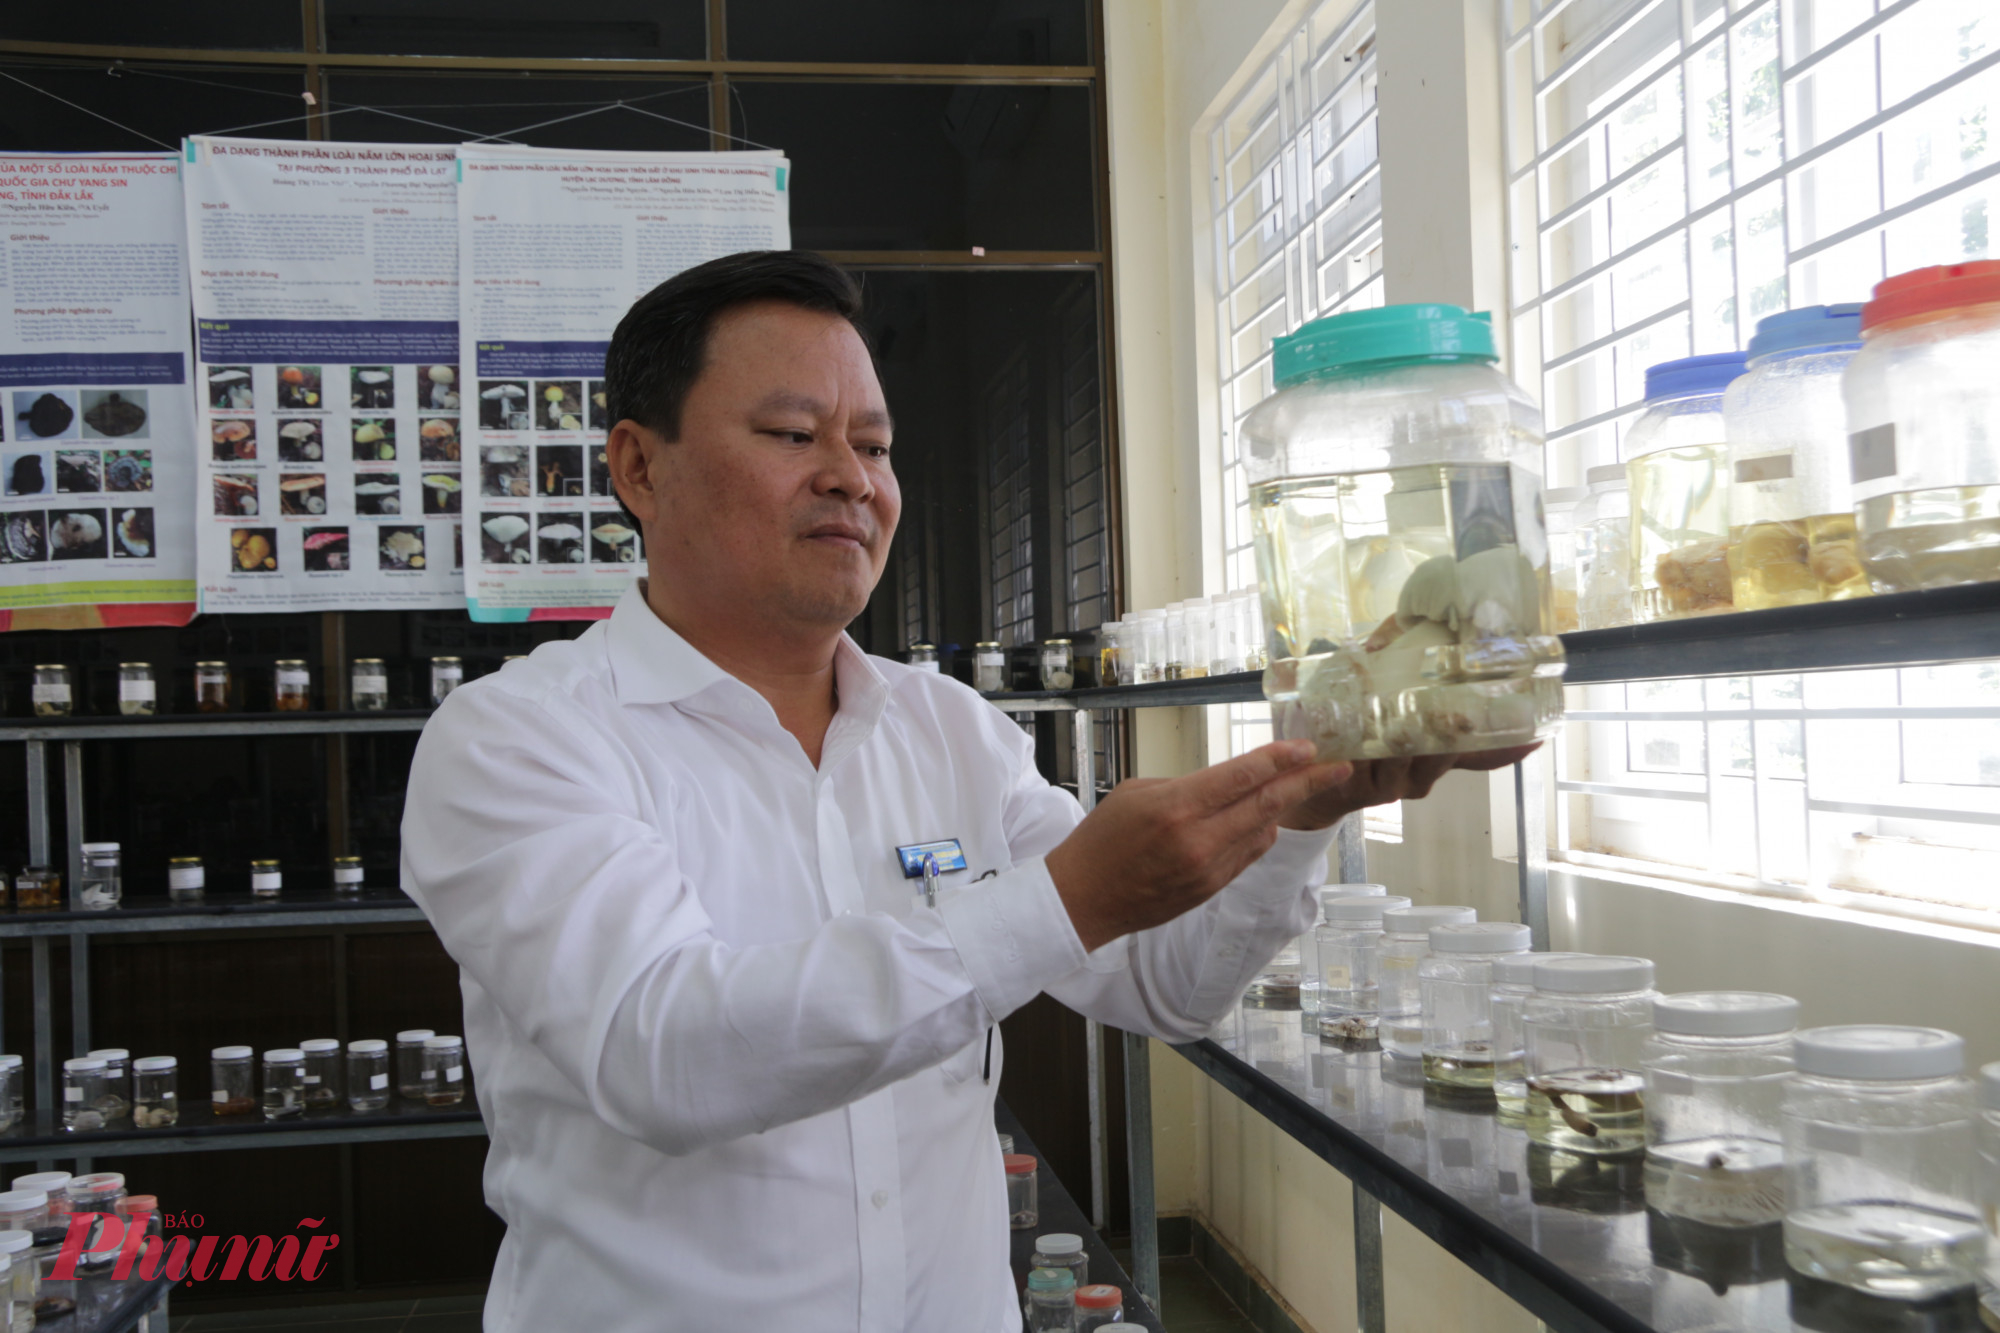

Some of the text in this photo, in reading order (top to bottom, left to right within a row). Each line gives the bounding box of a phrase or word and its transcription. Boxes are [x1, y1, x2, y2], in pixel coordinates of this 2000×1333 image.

[212, 146, 227, 155] ĐA
[262, 147, 299, 158] THÀNH
[332, 150, 356, 160] LOÀI
[385, 151, 406, 161] LỚN
[19, 163, 45, 175] MỘT
[47, 162, 63, 174] SỐ
[65, 163, 90, 174] LOÀI
[92, 163, 118, 174] NẤM
[121, 164, 157, 176] THUỘC
[159, 165, 177, 174] CHI
[296, 163, 342, 174] PHƯỜNG
[352, 165, 388, 175] THÀNH
[390, 165, 412, 175] PHỐ
[414, 166, 428, 175] ĐÀ
[30, 178, 50, 187] GIA
[52, 178, 77, 187] CHƯ
[79, 178, 108, 188] YANG
[110, 178, 128, 188] SIN
[20, 188, 47, 200] TỈNH
[49, 188, 72, 201] ĐẮK
[74, 188, 94, 201] LẮK
[10, 233, 50, 242] Giới thiệu
[14, 306, 113, 316] Phương pháp nghiên cứu
